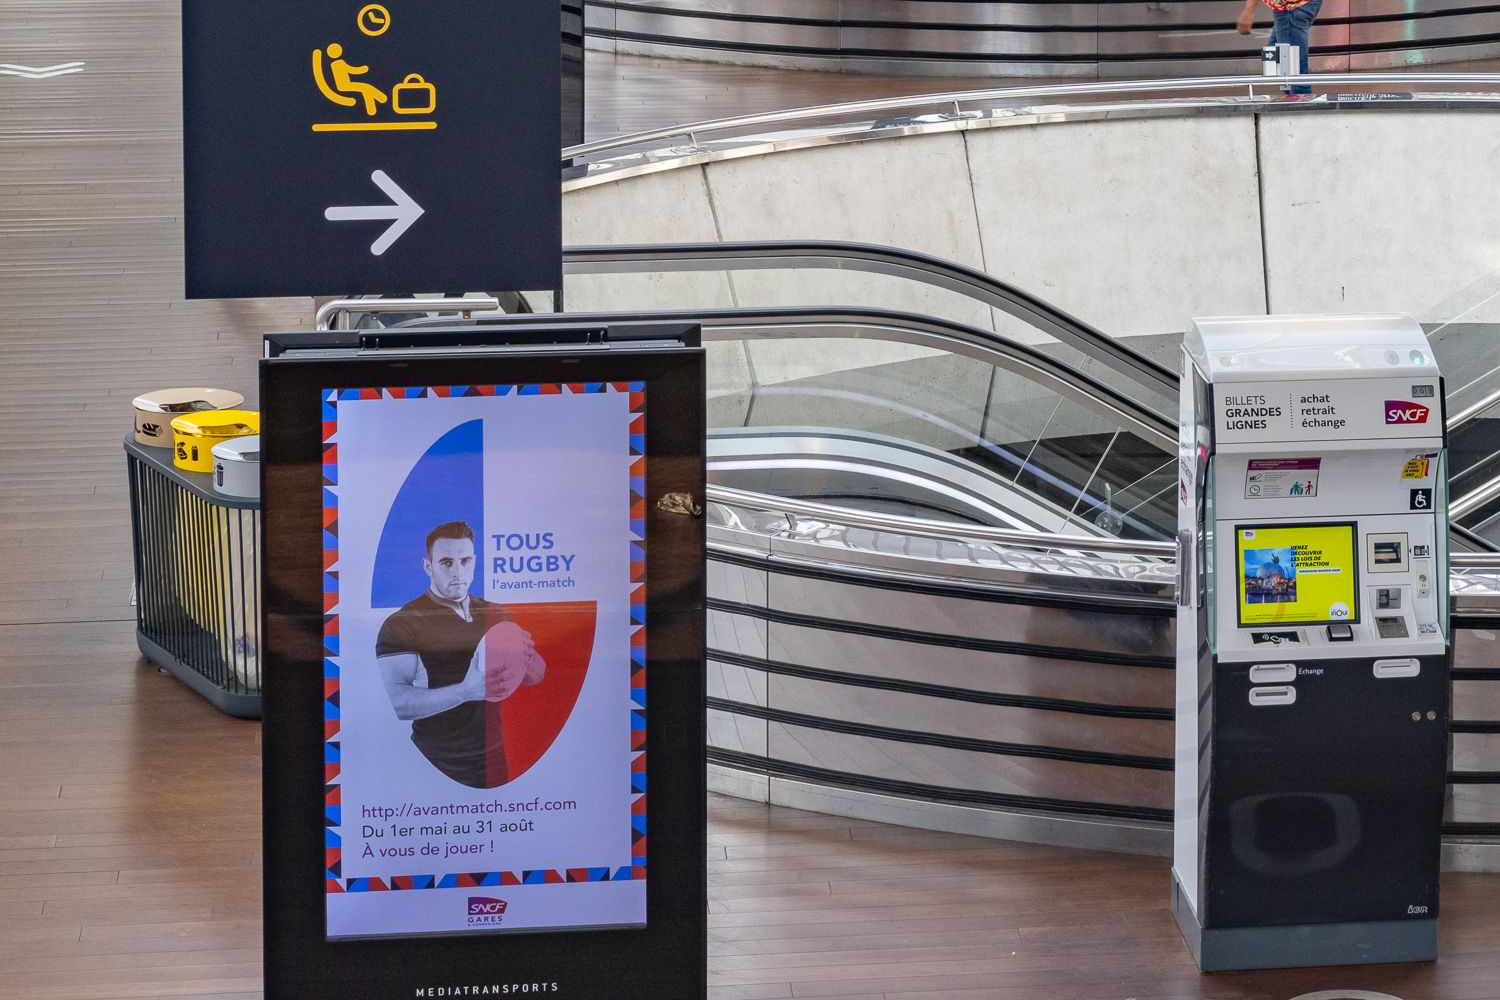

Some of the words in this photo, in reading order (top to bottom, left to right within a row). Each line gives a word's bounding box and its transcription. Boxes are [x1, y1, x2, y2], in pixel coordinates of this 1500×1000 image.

[1225, 396, 1266, 406] BILLETS
[1300, 394, 1330, 404] achat
[1225, 407, 1281, 418] GRANDES
[1301, 405, 1335, 415] retrait
[1387, 409, 1426, 422] SNCF
[1226, 420, 1267, 430] LIGNES
[1301, 418, 1346, 430] échange
[492, 532, 554, 552] TOUS
[493, 554, 576, 574] RUGBY
[492, 576, 575, 590] l'avant-match
[1298, 667, 1324, 676] Échange
[362, 797, 577, 821] http://avantmatch.sncf.com
[362, 825, 384, 838] Du
[390, 824, 415, 837] 1er
[420, 821, 448, 836] mai
[452, 824, 470, 835] au
[475, 820, 493, 834] 31
[500, 818, 534, 833] août
[362, 842, 375, 858] À
[379, 845, 415, 858] vous
[420, 843, 440, 856] de
[444, 842, 485, 858] jouer
[490, 840, 494, 853] !
[470, 902, 505, 914] SNCF
[416, 982, 559, 997] MEDIATRANSPORTS
